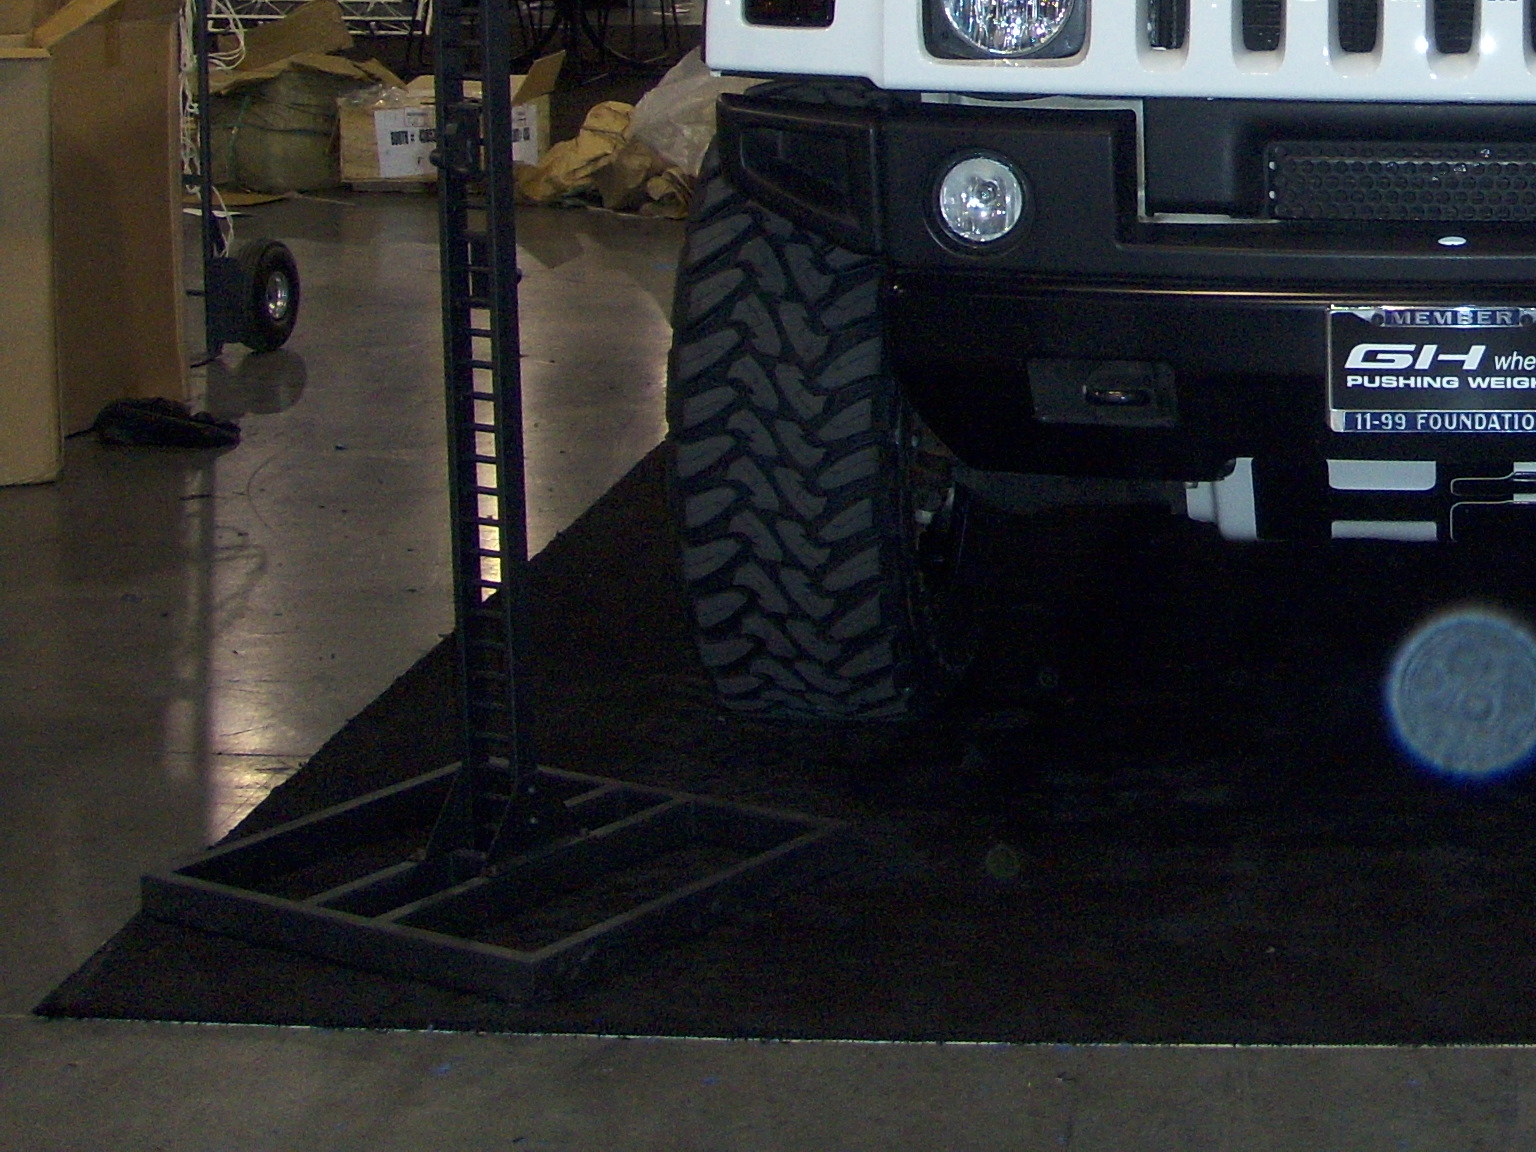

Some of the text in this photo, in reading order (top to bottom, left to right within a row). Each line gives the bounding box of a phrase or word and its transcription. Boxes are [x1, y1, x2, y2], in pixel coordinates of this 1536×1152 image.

[1390, 311, 1514, 326] MEMBER
[1344, 343, 1487, 371] GH
[1346, 376, 1460, 389] PUSHING
[1354, 412, 1407, 430] 11-99
